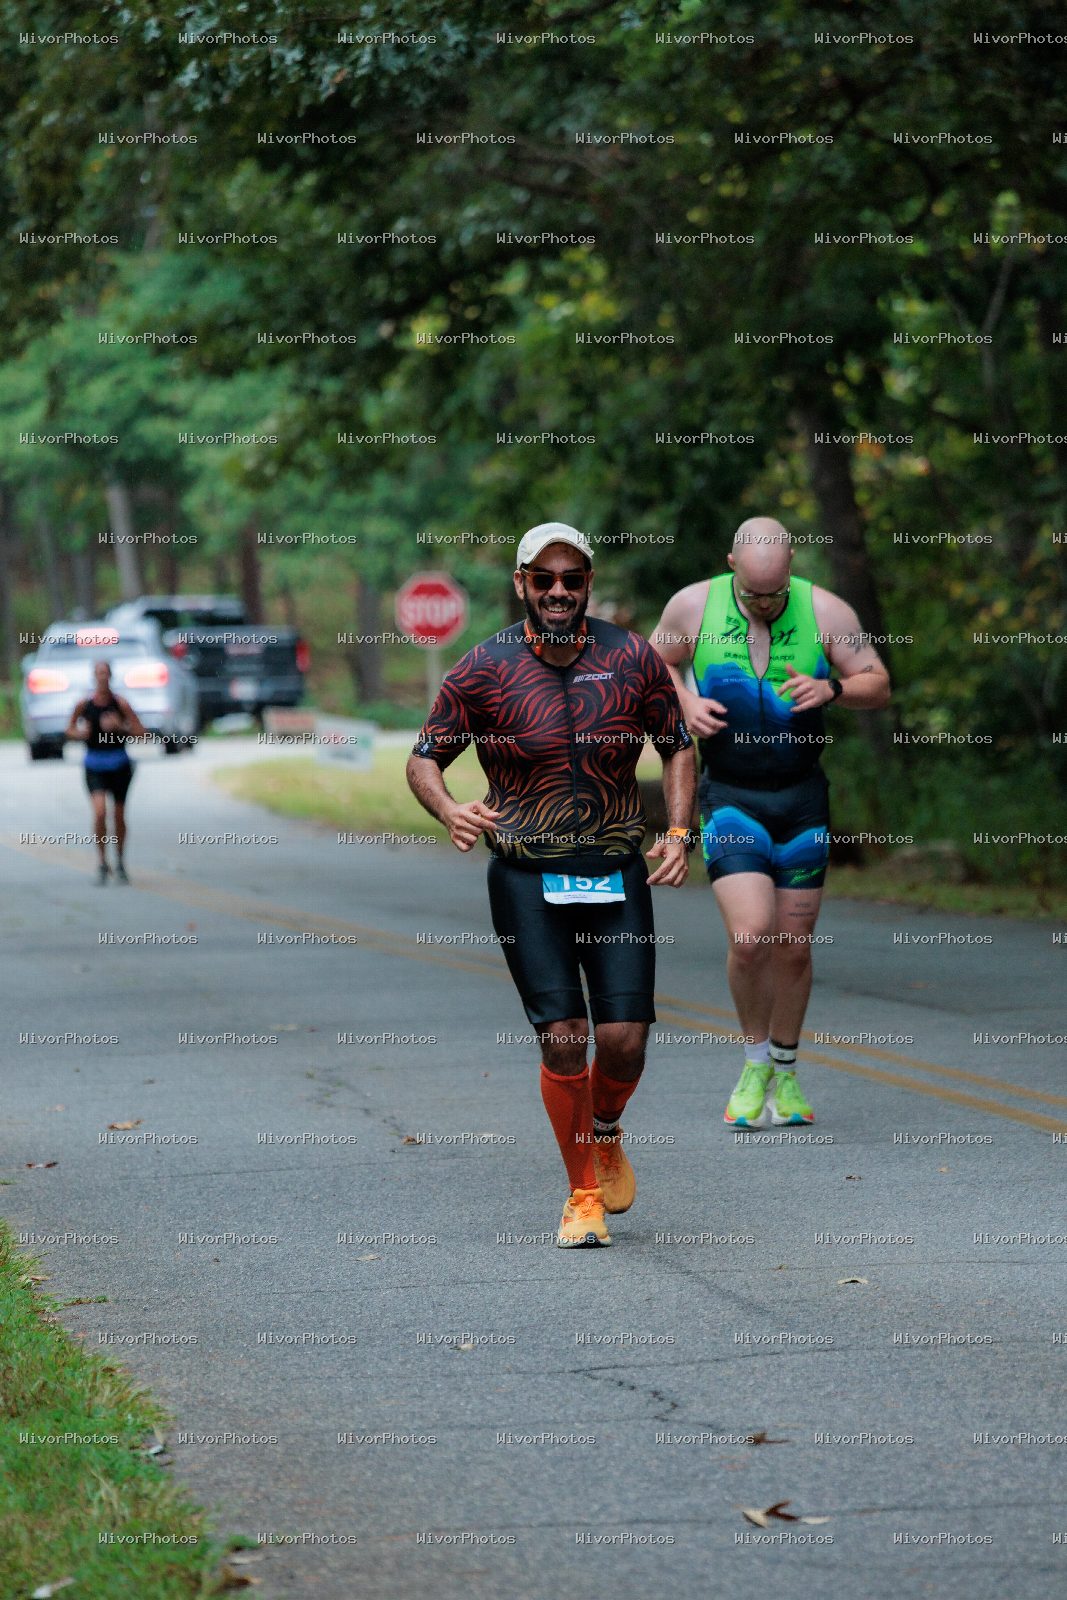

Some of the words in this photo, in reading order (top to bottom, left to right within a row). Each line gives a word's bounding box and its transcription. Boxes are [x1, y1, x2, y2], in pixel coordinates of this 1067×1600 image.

[401, 596, 464, 627] STOP
[583, 672, 614, 681] ZOOT
[557, 874, 612, 892] 152
